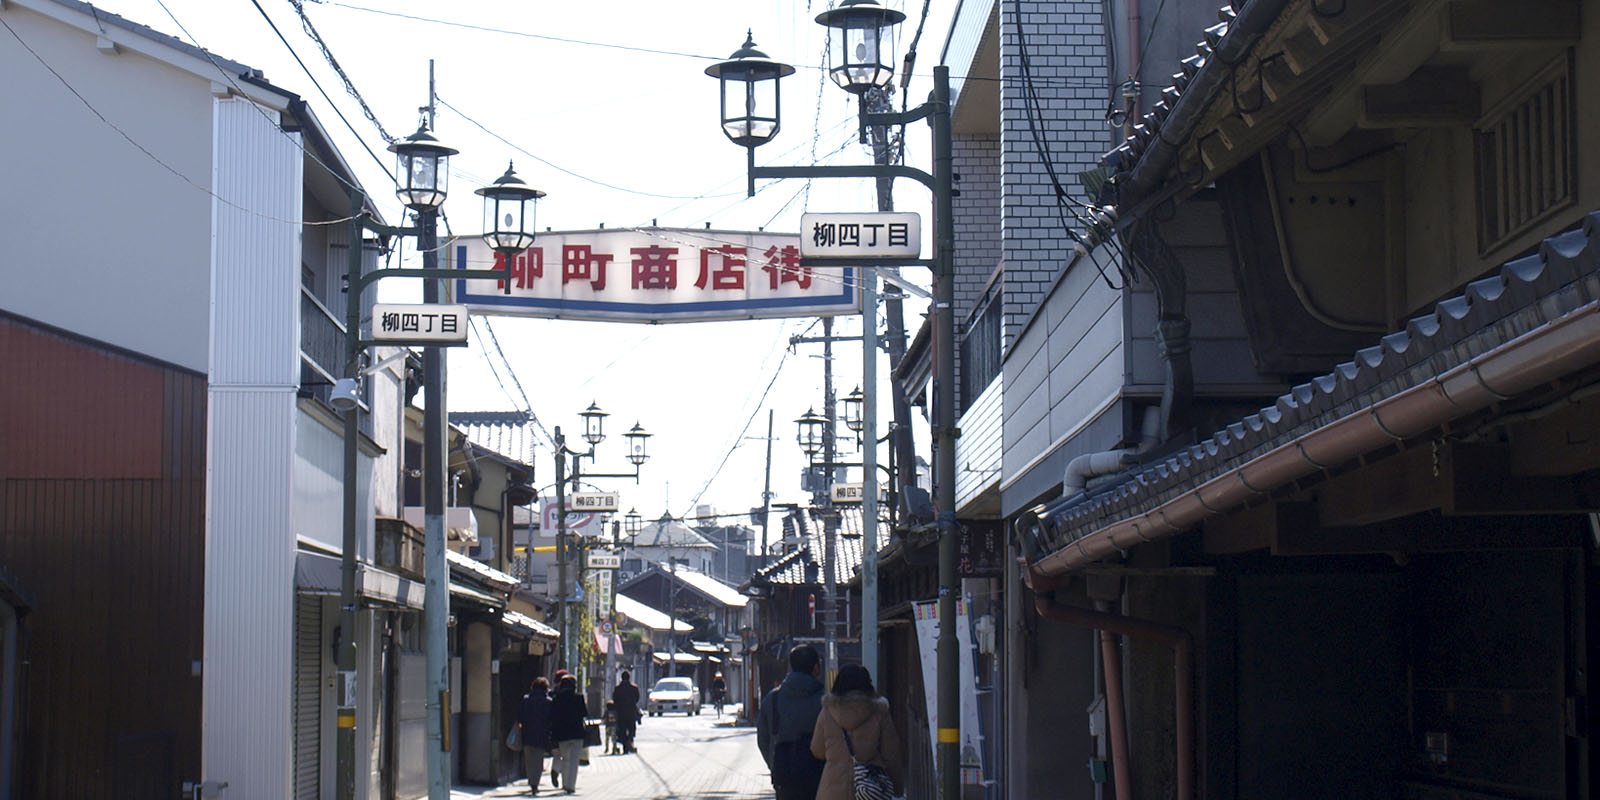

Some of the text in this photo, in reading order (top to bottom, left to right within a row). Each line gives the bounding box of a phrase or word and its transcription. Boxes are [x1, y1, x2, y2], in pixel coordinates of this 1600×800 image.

[813, 222, 908, 247] 柳四丁目
[493, 244, 811, 290] 柳町商店街
[381, 311, 457, 333] 柳四丁目
[576, 496, 613, 506] 柳四丁目
